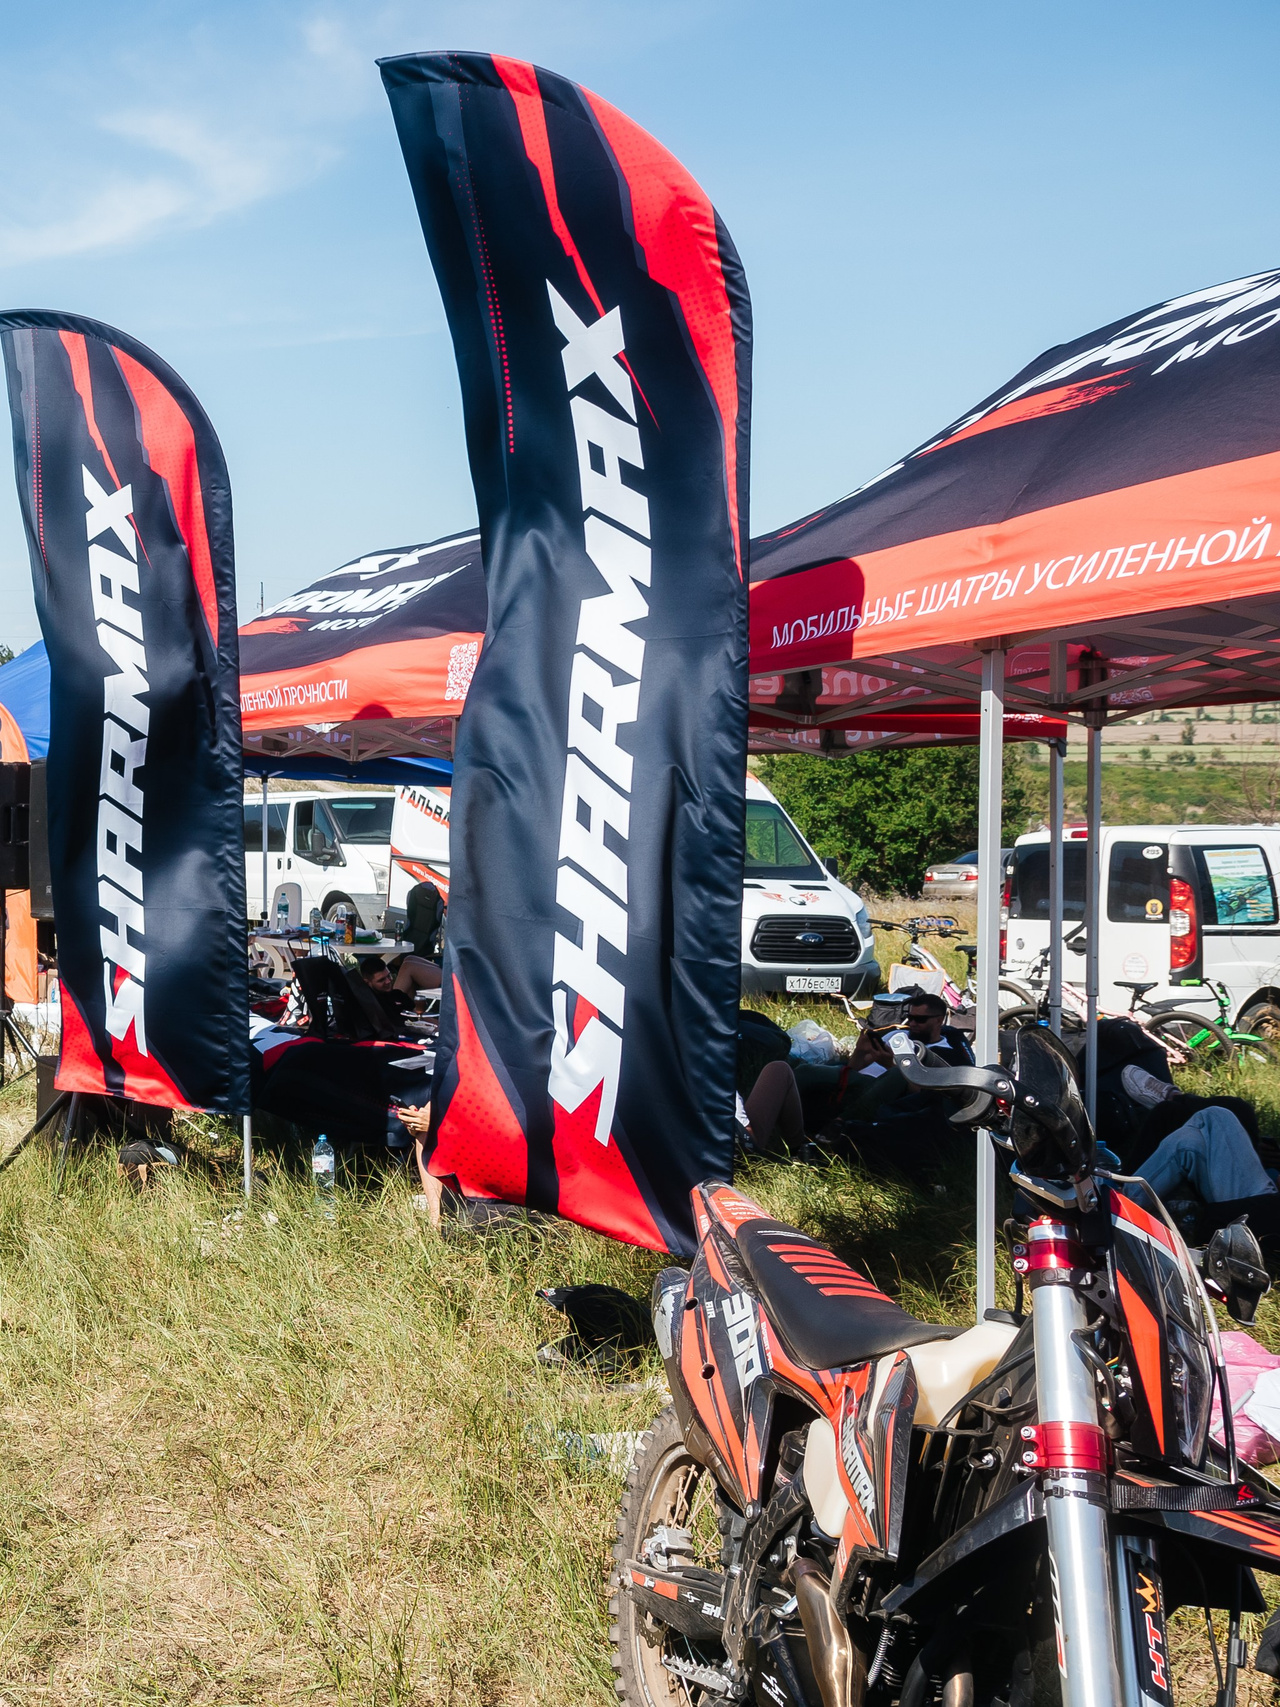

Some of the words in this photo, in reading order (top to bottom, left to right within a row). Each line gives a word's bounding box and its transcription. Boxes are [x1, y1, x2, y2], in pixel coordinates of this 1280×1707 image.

[770, 589, 916, 649] МОБИЛЬНЫЕ
[915, 565, 1025, 617] ШАТРЫ
[1023, 515, 1273, 595] УСИЛЕННОЙ
[239, 685, 283, 713] ЛЕННОЙ
[283, 679, 348, 707] ПРОЧНОСТИ
[545, 278, 652, 1147] SHARMAX
[82, 463, 151, 1057] SHARMAX
[704, 1300, 716, 1319] AIR
[721, 1292, 763, 1388] 300
[760, 1321, 770, 1349] EXPERT
[766, 1350, 774, 1370] PRO
